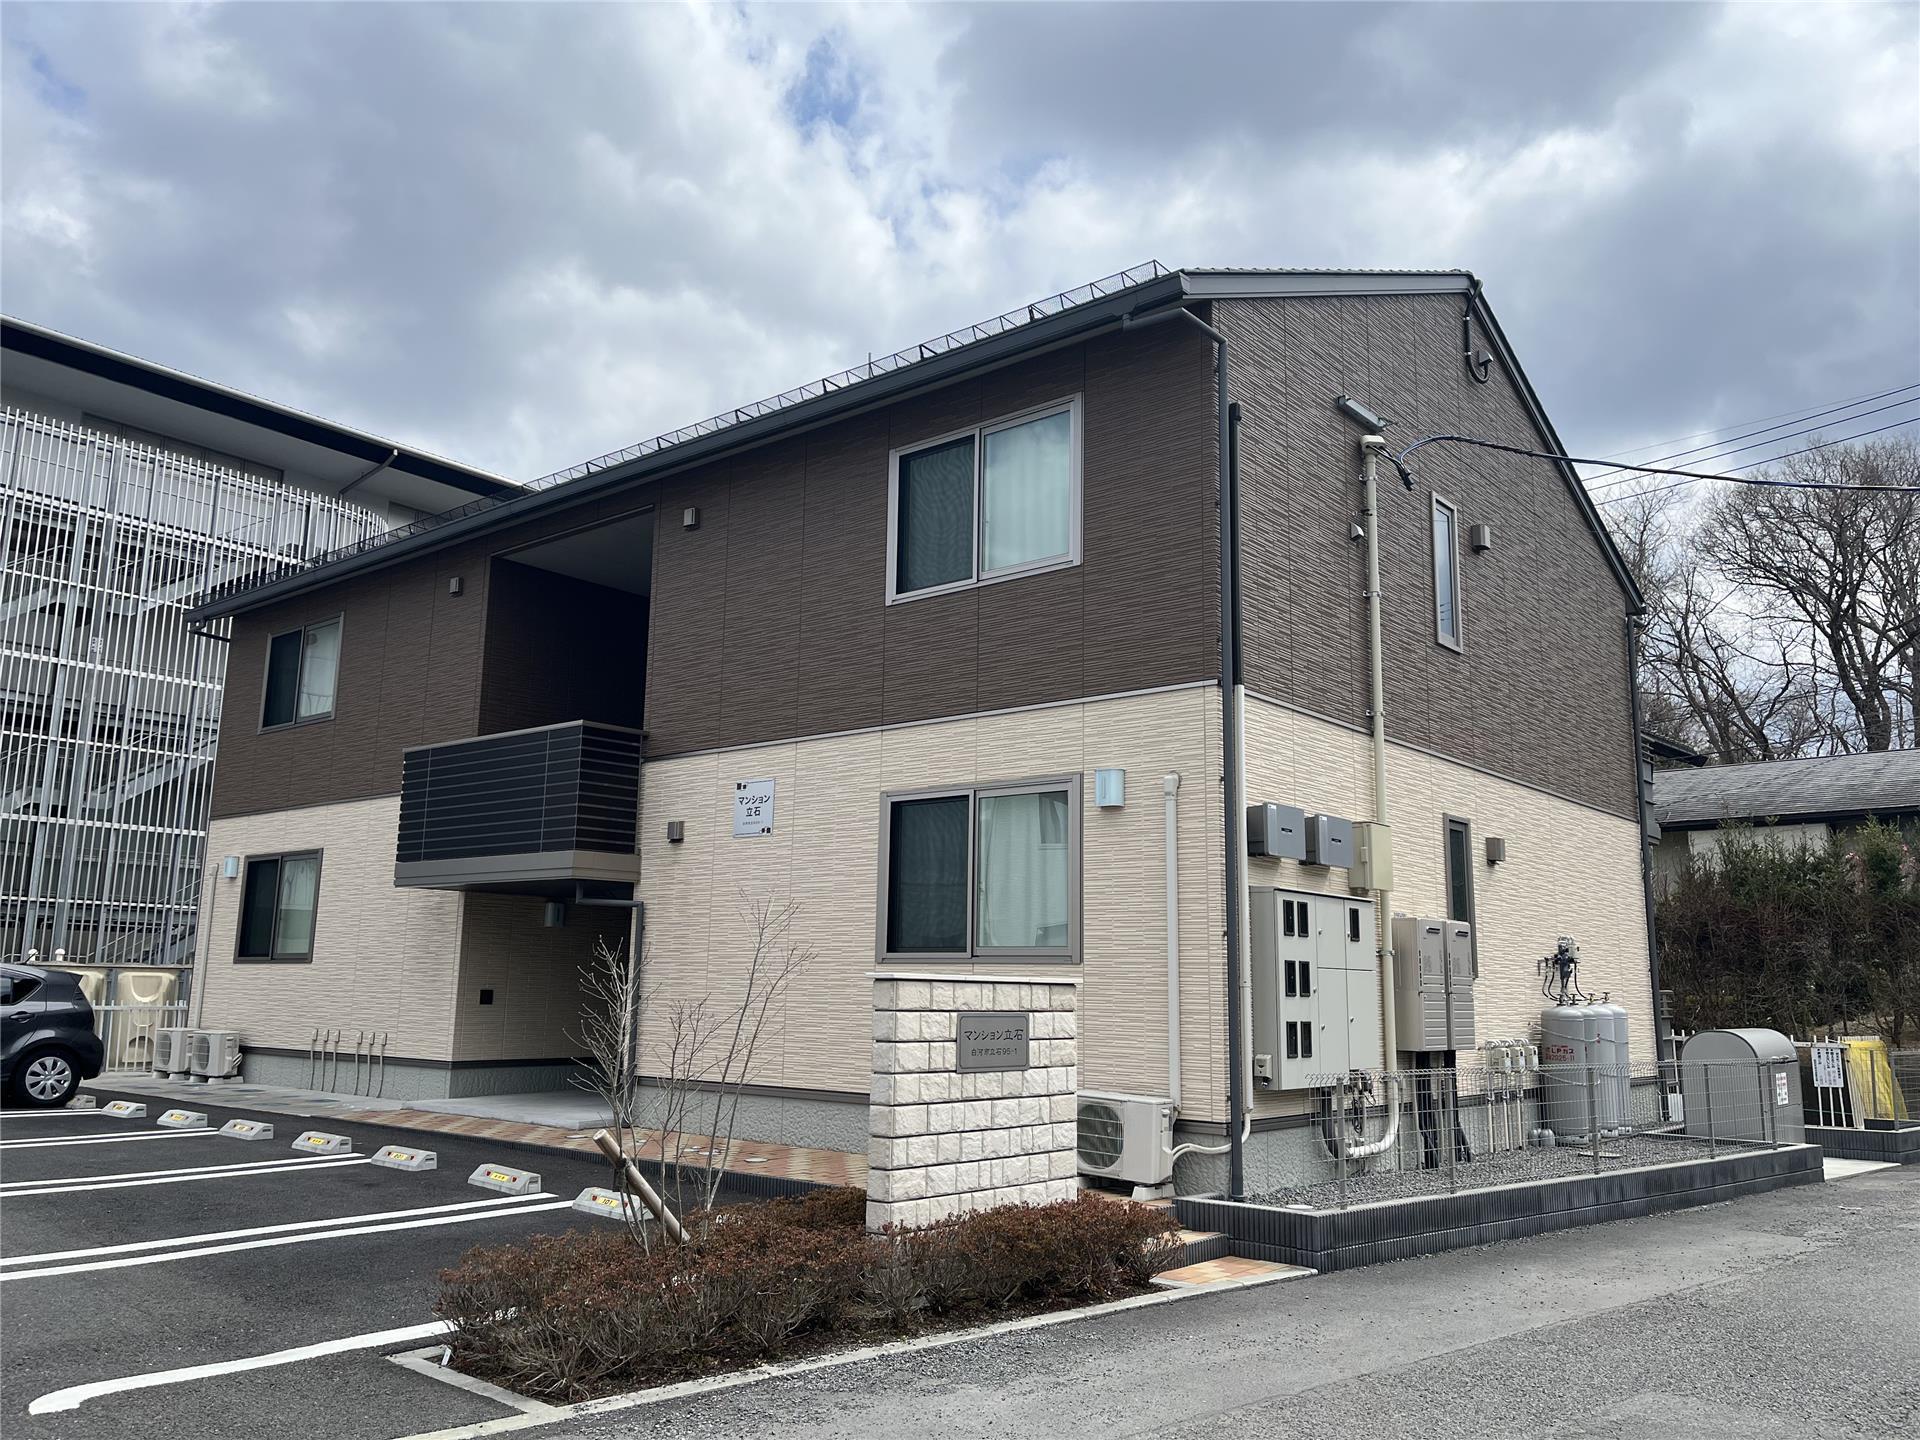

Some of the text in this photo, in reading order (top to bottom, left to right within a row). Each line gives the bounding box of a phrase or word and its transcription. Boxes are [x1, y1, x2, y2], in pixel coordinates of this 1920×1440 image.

[738, 795, 771, 805] マンション
[746, 806, 761, 817] 立石
[964, 1029, 1024, 1041] マンション立石
[602, 1198, 613, 1206] 101
